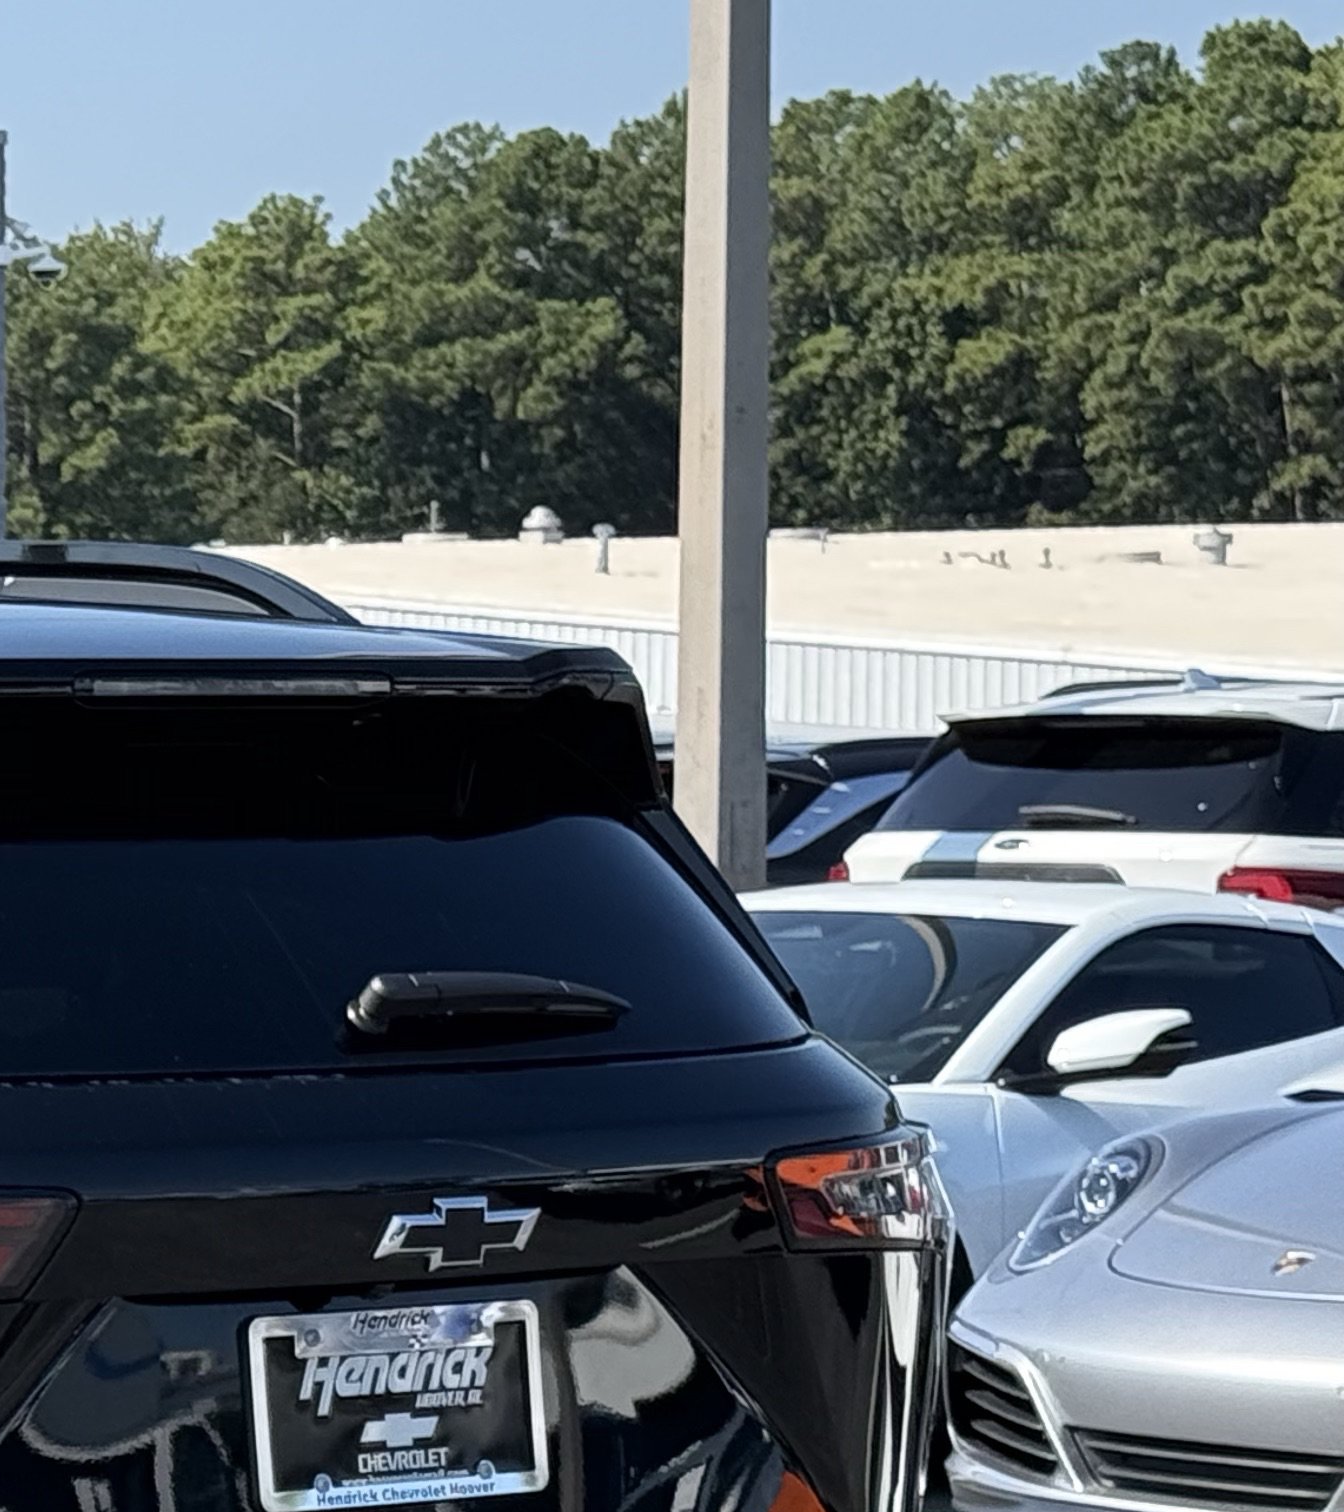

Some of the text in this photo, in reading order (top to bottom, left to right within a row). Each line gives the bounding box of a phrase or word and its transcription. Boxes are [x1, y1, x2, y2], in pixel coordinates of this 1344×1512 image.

[352, 1309, 431, 1331] Hendrick
[299, 1348, 493, 1417] Hendrick
[358, 1447, 450, 1474] CHEVROLET
[317, 1481, 496, 1506] Hendrick Chevrolet Hoover
